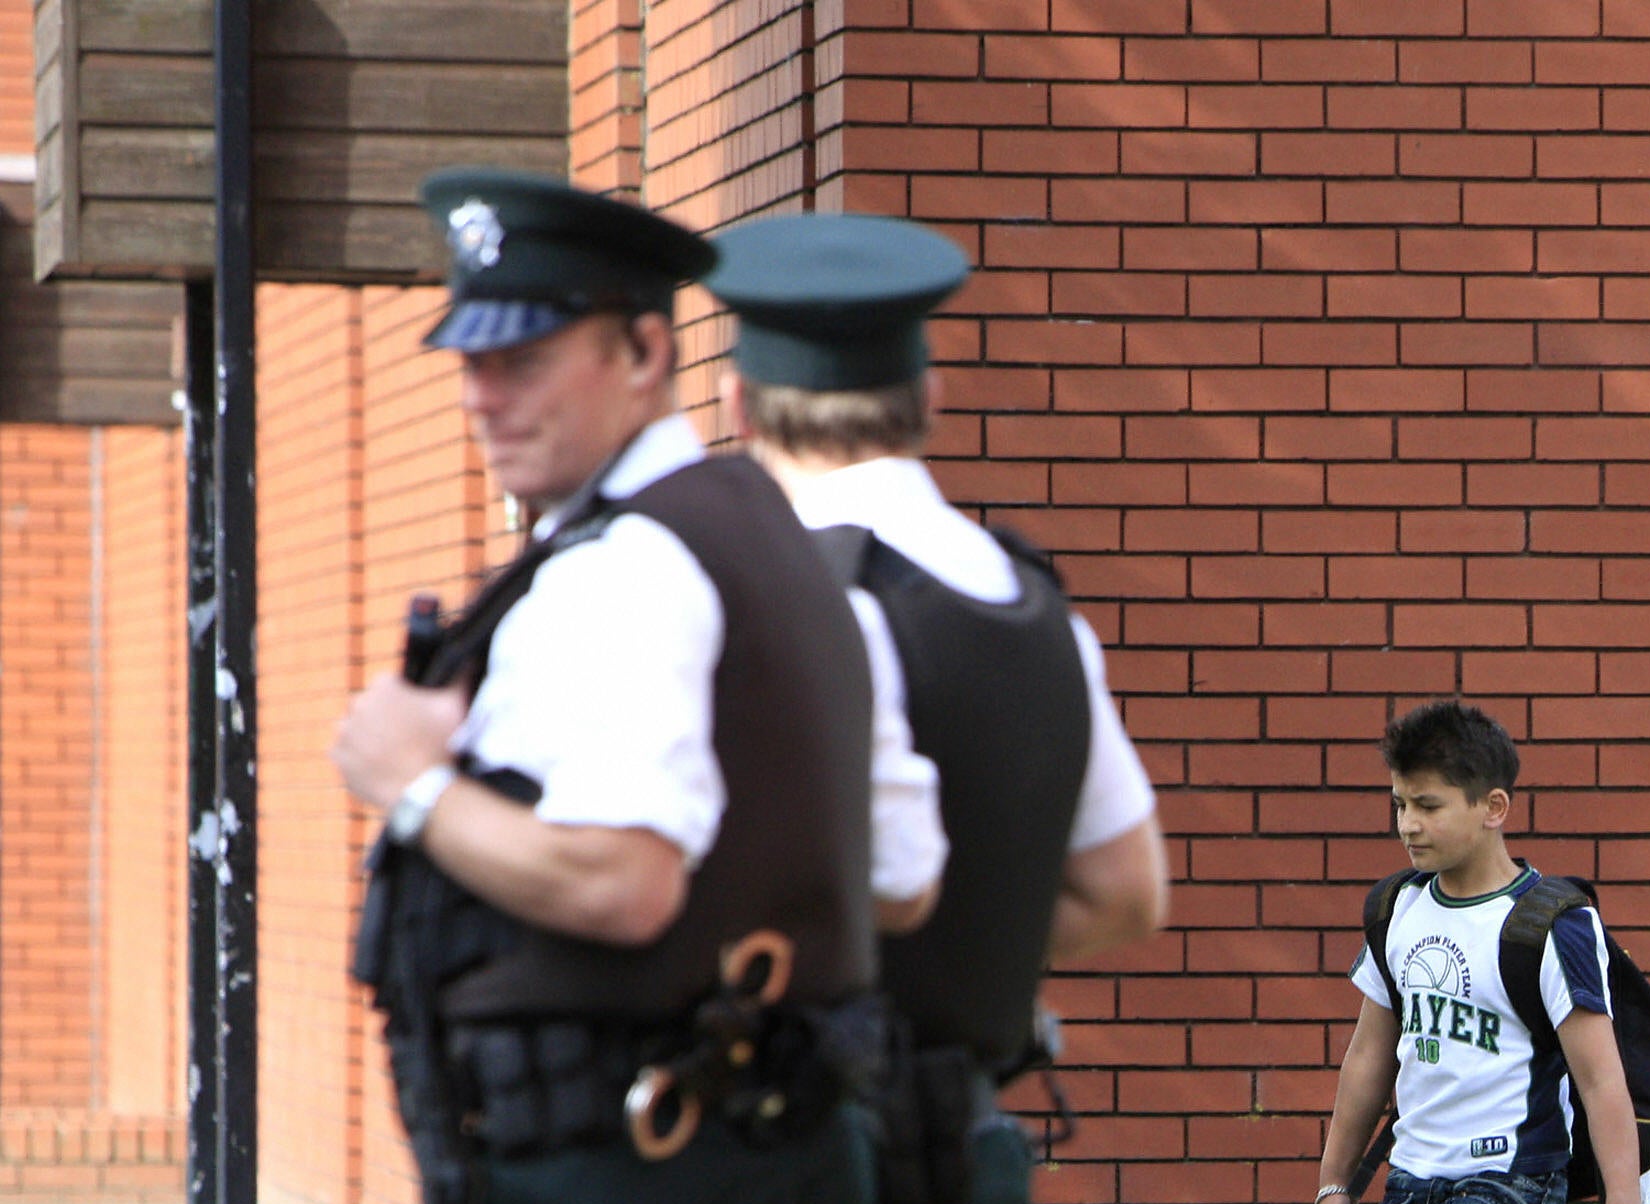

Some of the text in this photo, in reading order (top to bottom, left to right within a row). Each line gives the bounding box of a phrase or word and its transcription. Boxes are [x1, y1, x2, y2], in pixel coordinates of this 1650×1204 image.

[1403, 934, 1442, 967] CHAMPION
[1442, 936, 1467, 967] PLAYER
[1461, 967, 1472, 999] TEAM
[1415, 1037, 1440, 1065] 10
